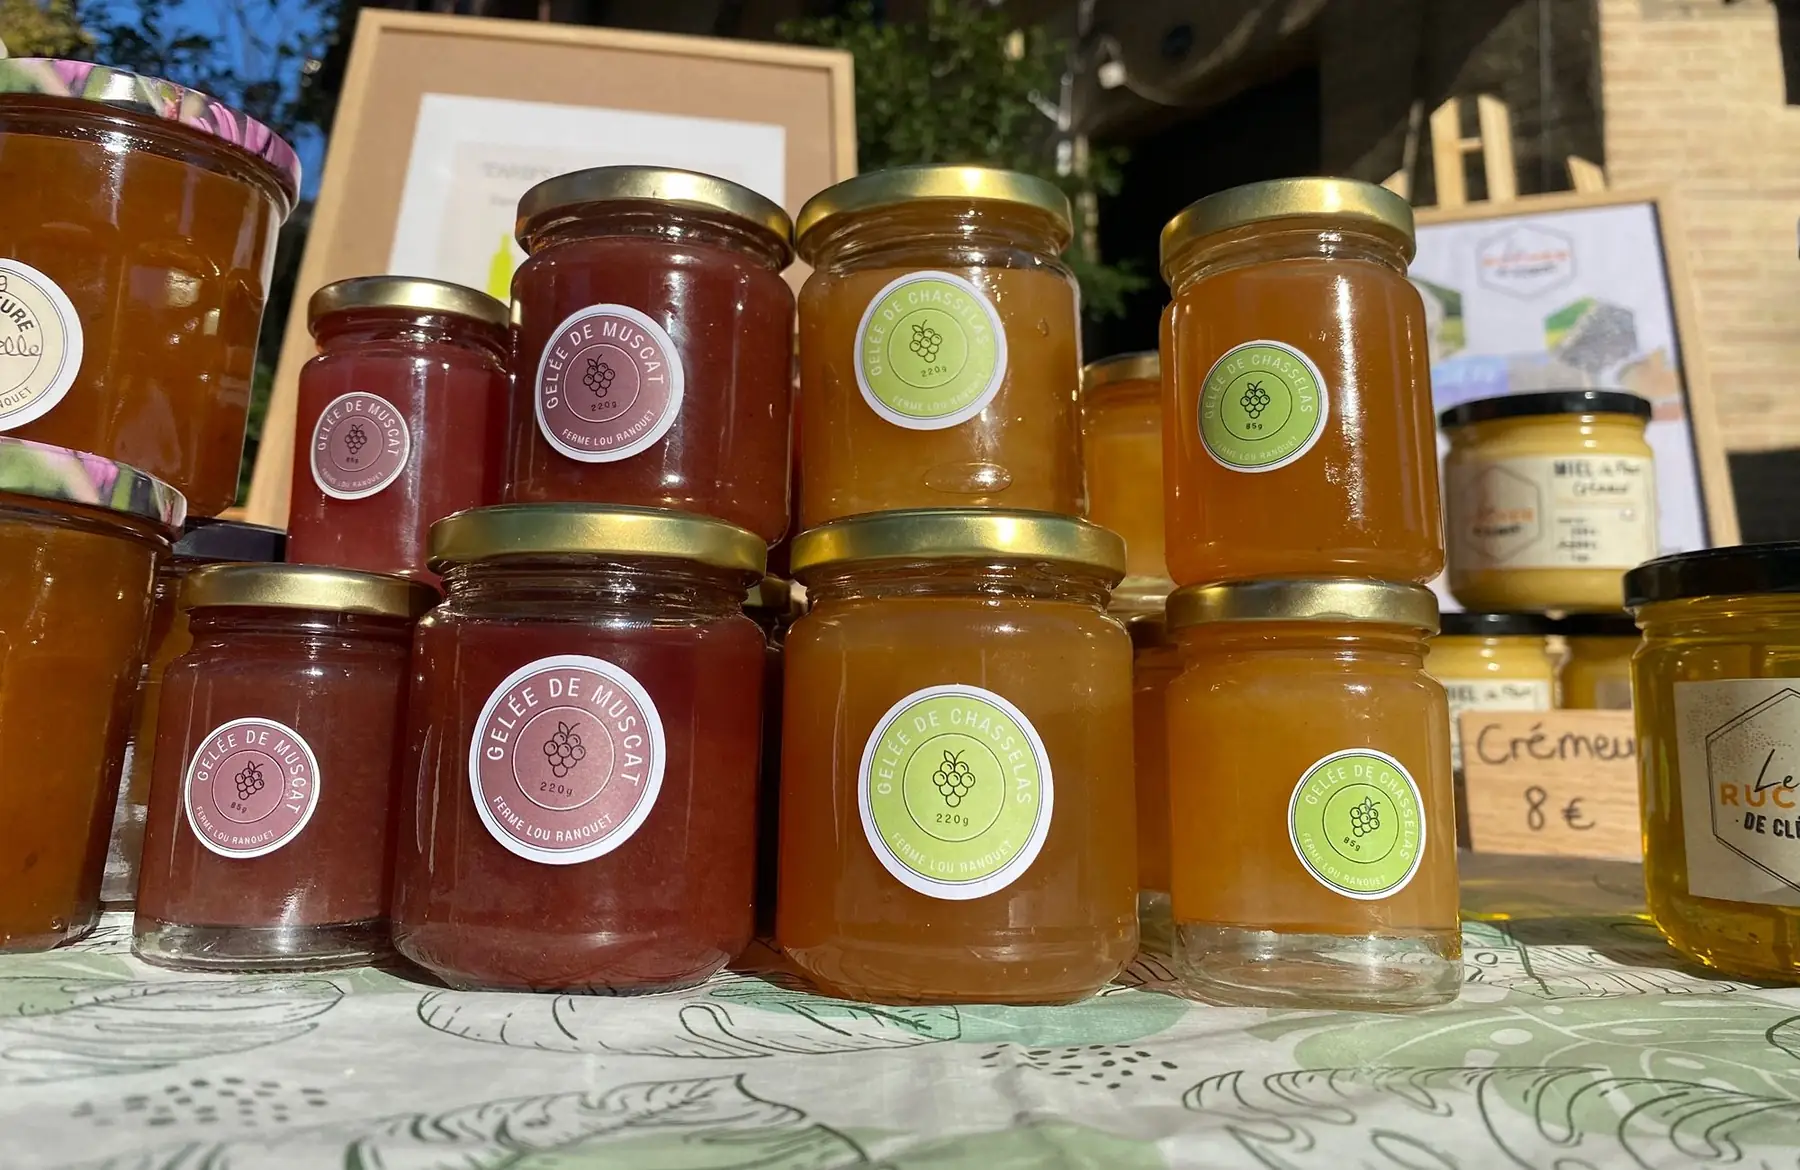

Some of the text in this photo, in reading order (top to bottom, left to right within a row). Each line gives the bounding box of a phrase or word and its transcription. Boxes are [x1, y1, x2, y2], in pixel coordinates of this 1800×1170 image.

[0, 295, 34, 332] URE
[883, 300, 904, 321] DE
[545, 321, 664, 409] GELÉE DE MUSCAT
[920, 366, 947, 377] 220g
[1226, 358, 1245, 375] DE
[1251, 354, 1313, 413] CHASSELAS
[591, 401, 617, 412] 220g
[345, 400, 362, 413] DE
[368, 402, 400, 456] MUSCAT
[562, 410, 656, 446] FERME LOU RANQUET
[486, 677, 643, 786] GELÉE DE MUSCAT
[197, 730, 307, 815] GELÉE DE MUSCAT
[877, 708, 1032, 805] GELÉE DE CHASSELAS
[230, 802, 248, 813] 85g
[540, 781, 573, 798] 220g
[1525, 785, 1596, 831] 8 €
[1720, 781, 1796, 809] RUC
[196, 805, 275, 845] FERME LOU RANQUET
[493, 795, 613, 841] FERME LOU RANQUET
[936, 813, 969, 827] 220g
[1304, 764, 1415, 860] GELÉE DE CHASSELAS
[1743, 811, 1767, 835] DE
[891, 832, 927, 865] FERME
[929, 860, 955, 873] LOU
[1303, 832, 1324, 863] FERME
[1323, 862, 1341, 879] LOU
[1343, 836, 1361, 852] 85g
